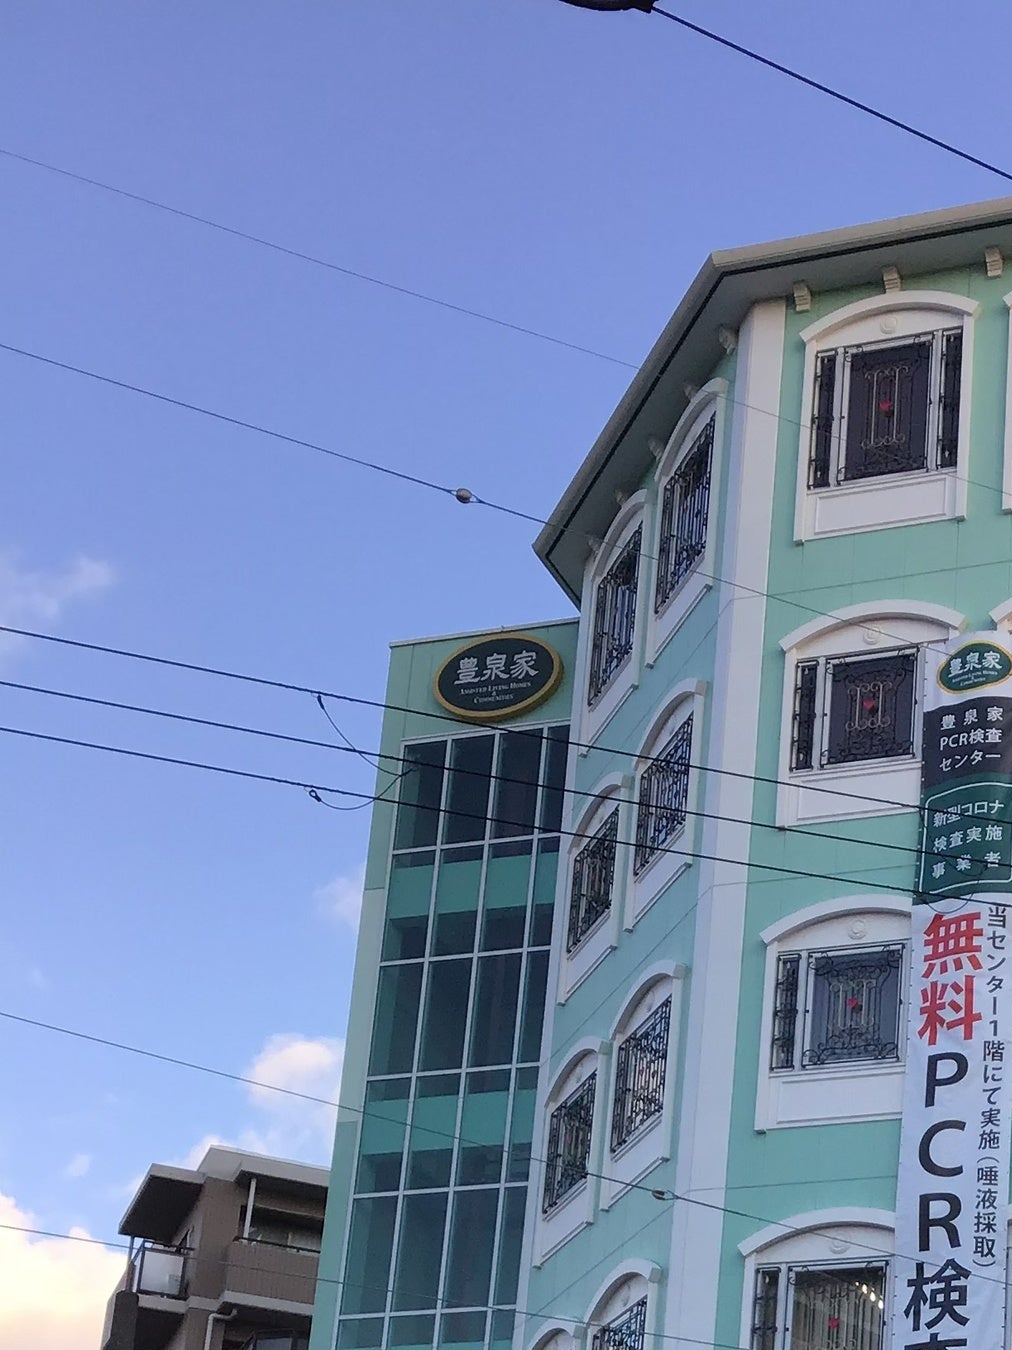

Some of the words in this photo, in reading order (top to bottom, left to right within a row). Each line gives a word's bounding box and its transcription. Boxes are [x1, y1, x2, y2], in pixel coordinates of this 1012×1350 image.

[454, 650, 539, 685] 豊泉家
[948, 651, 1002, 677] 豊泉家
[940, 706, 1003, 731] 豊泉家
[940, 728, 1002, 751] PCR検査
[939, 750, 1001, 772] センター
[933, 800, 1004, 828] 新型コロナ
[932, 824, 1003, 852] 検査実施
[932, 851, 1001, 880] 事業者
